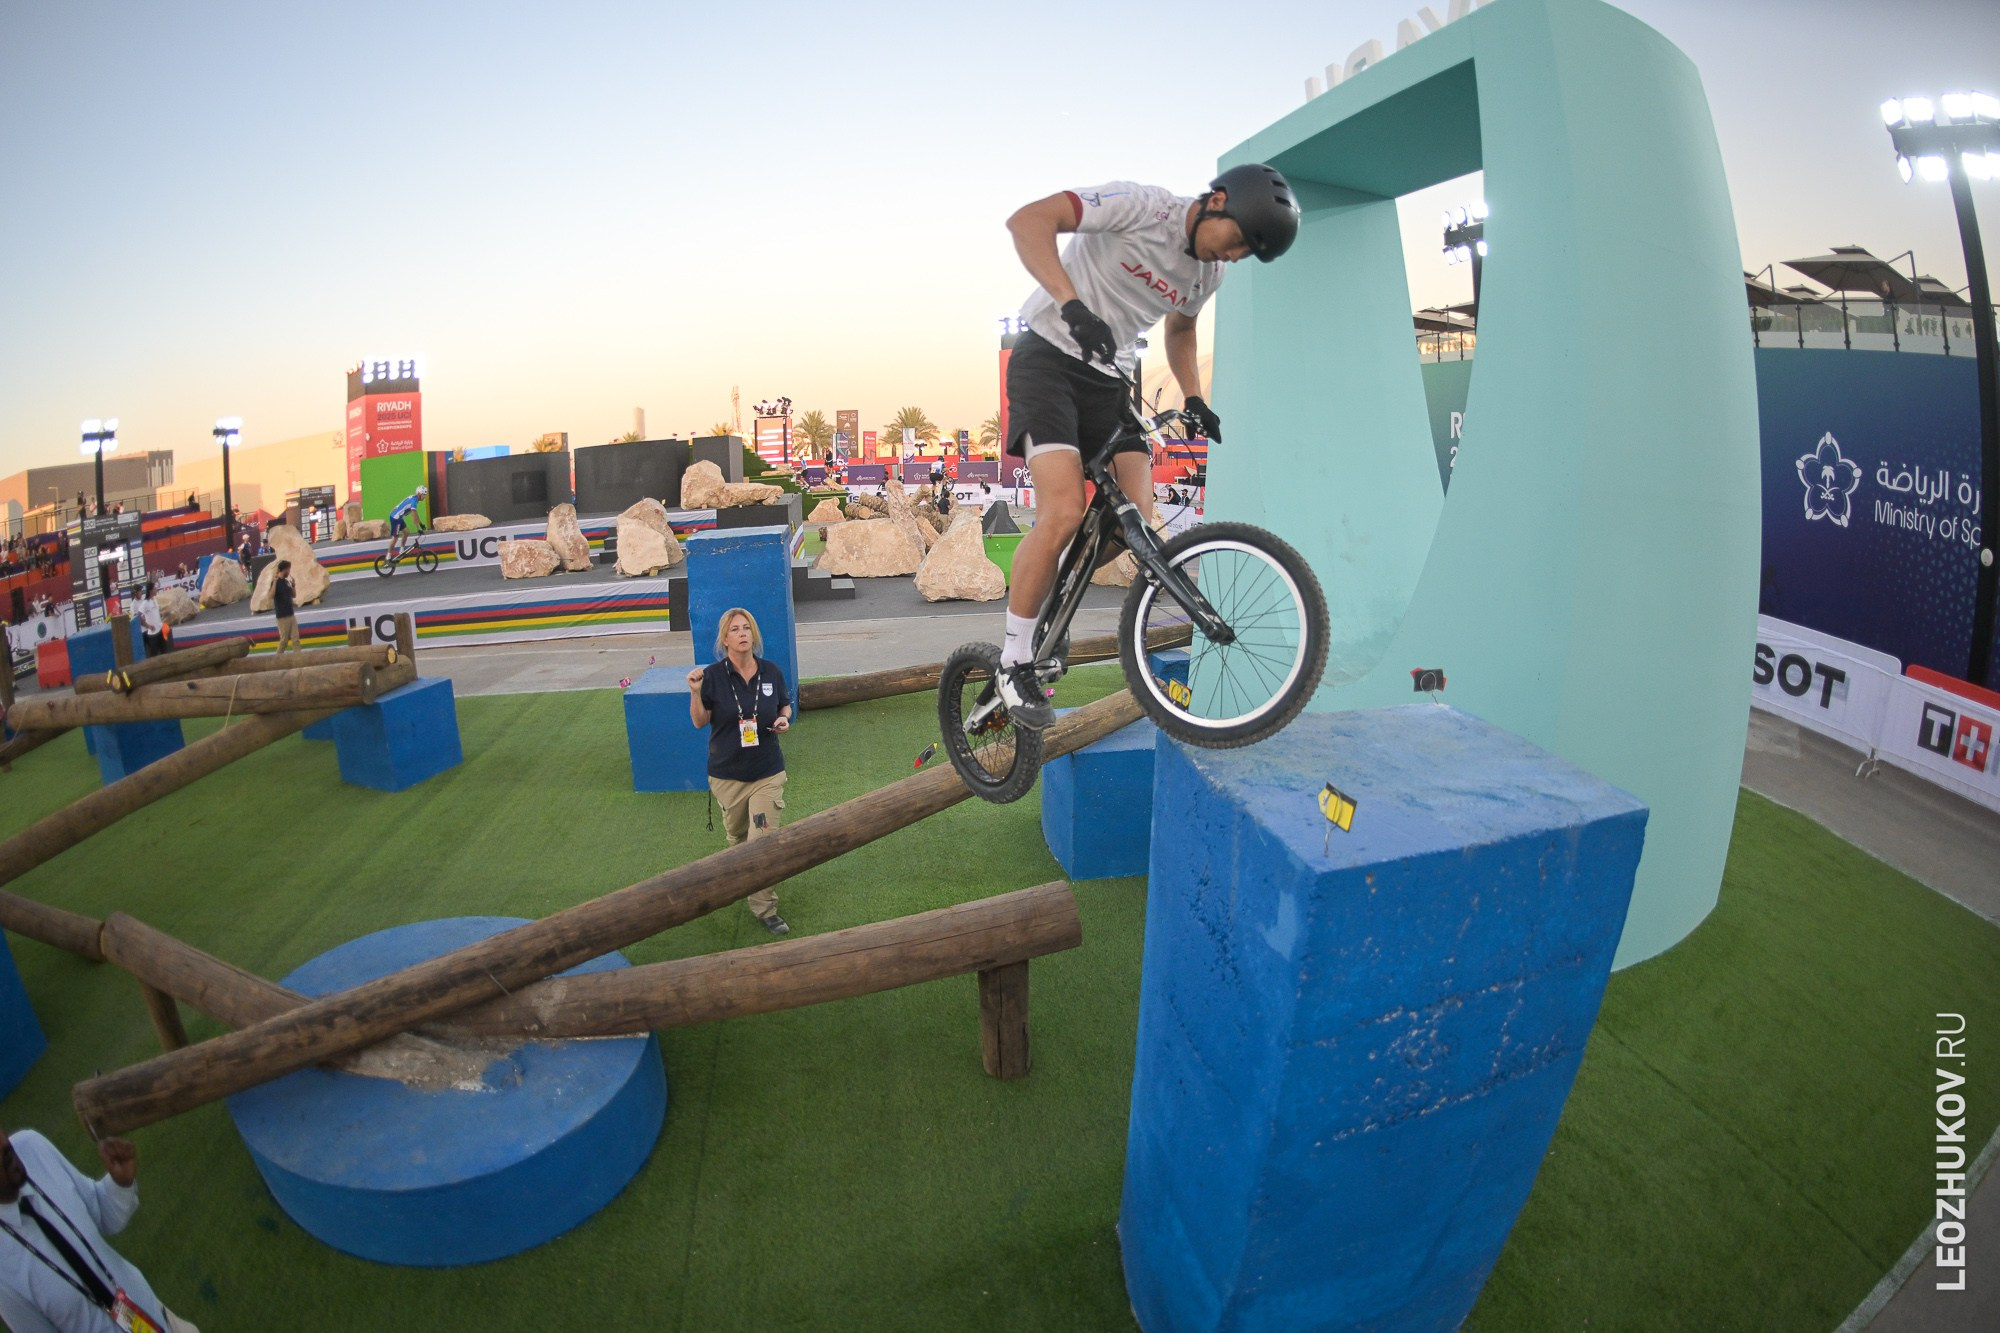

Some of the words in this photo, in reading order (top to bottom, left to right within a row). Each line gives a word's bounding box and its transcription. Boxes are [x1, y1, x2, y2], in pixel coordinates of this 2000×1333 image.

[377, 400, 412, 412] RIYADH
[1450, 411, 1466, 440] R
[1876, 460, 1949, 505] الرياضة
[1874, 499, 1936, 540] Ministry
[1939, 516, 1958, 540] of
[457, 535, 507, 561] UC
